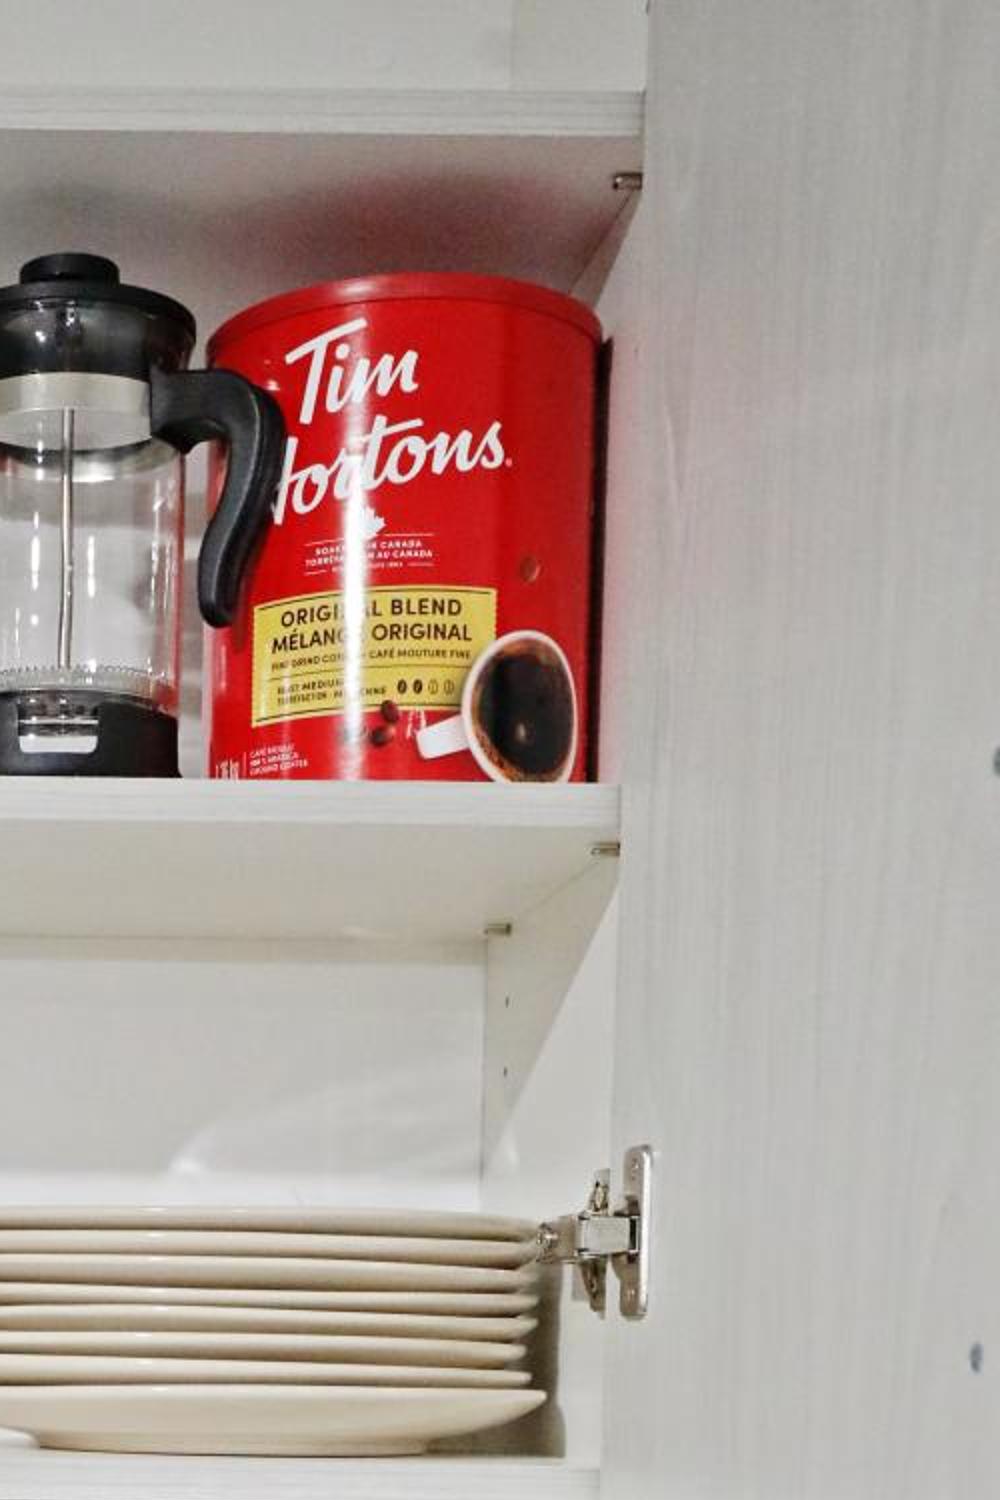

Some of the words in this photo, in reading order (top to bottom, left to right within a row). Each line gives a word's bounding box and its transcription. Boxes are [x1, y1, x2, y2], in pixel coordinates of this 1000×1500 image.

[285, 318, 419, 425] Tim
[281, 601, 382, 627] ORIGIL
[391, 597, 462, 616] BLEND
[271, 628, 368, 654] MÉLAN
[371, 622, 473, 642] ORIGINAL
[368, 648, 396, 659] CAFÉ
